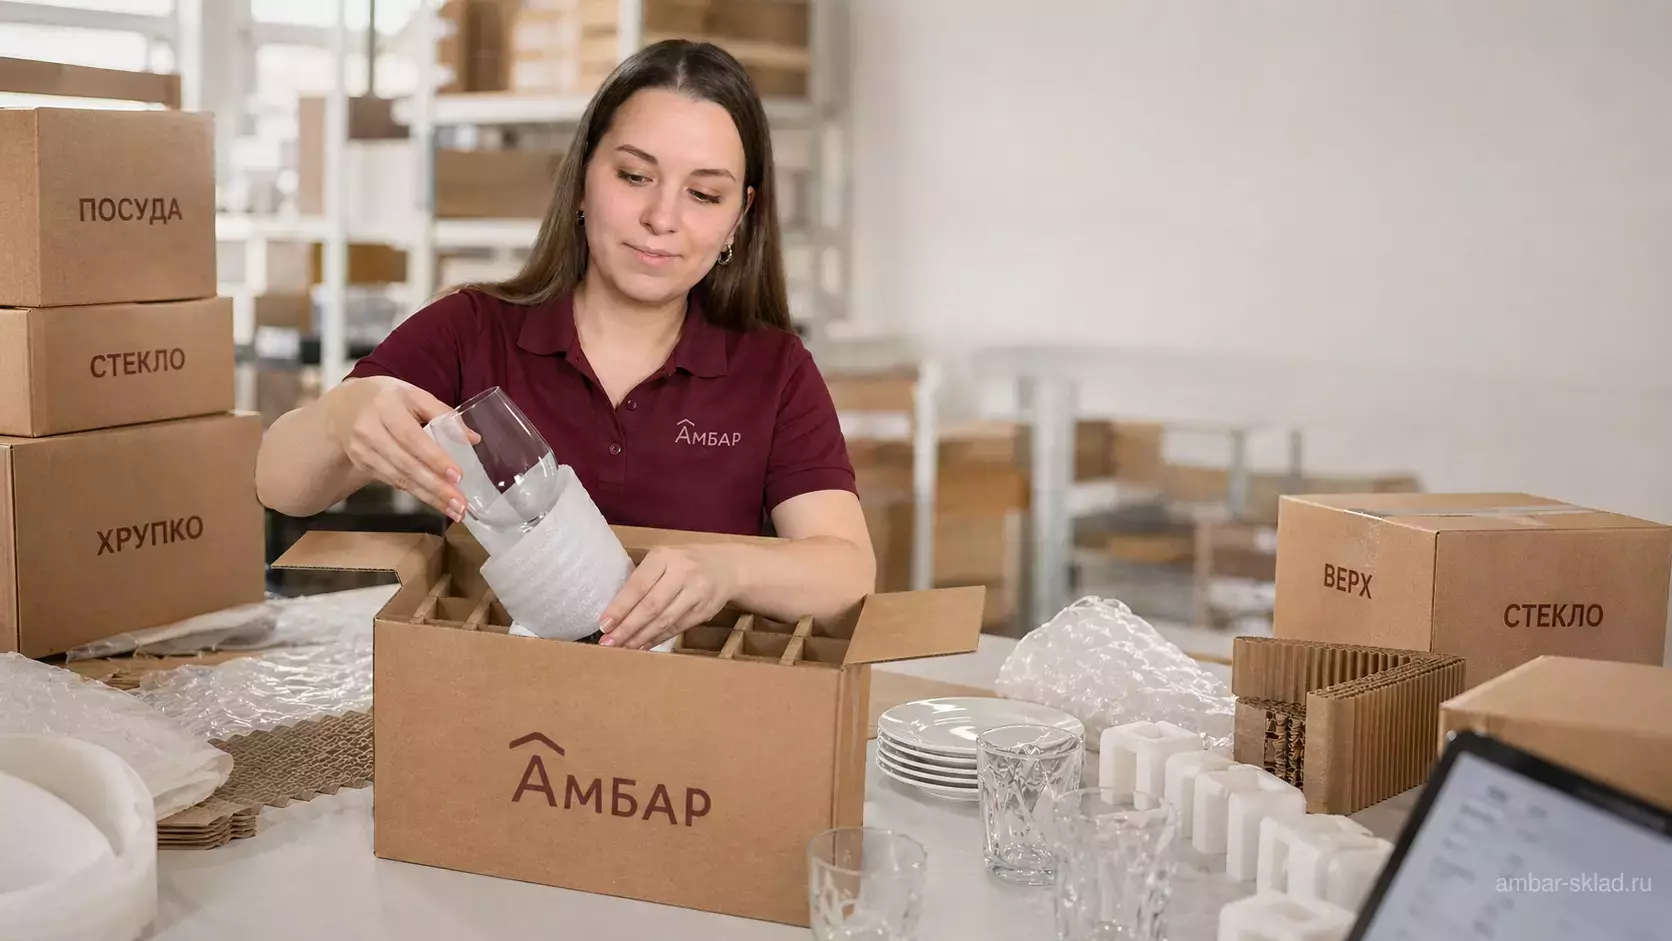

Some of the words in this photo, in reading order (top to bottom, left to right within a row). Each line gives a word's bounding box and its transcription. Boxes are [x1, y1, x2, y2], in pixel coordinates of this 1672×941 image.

[79, 197, 183, 225] ПОСУДА
[90, 347, 186, 378] СТЕКЛО
[96, 515, 204, 556] ХРУПКО
[1323, 562, 1373, 599] ВЕРХ
[1503, 602, 1604, 629] СТЕКЛО
